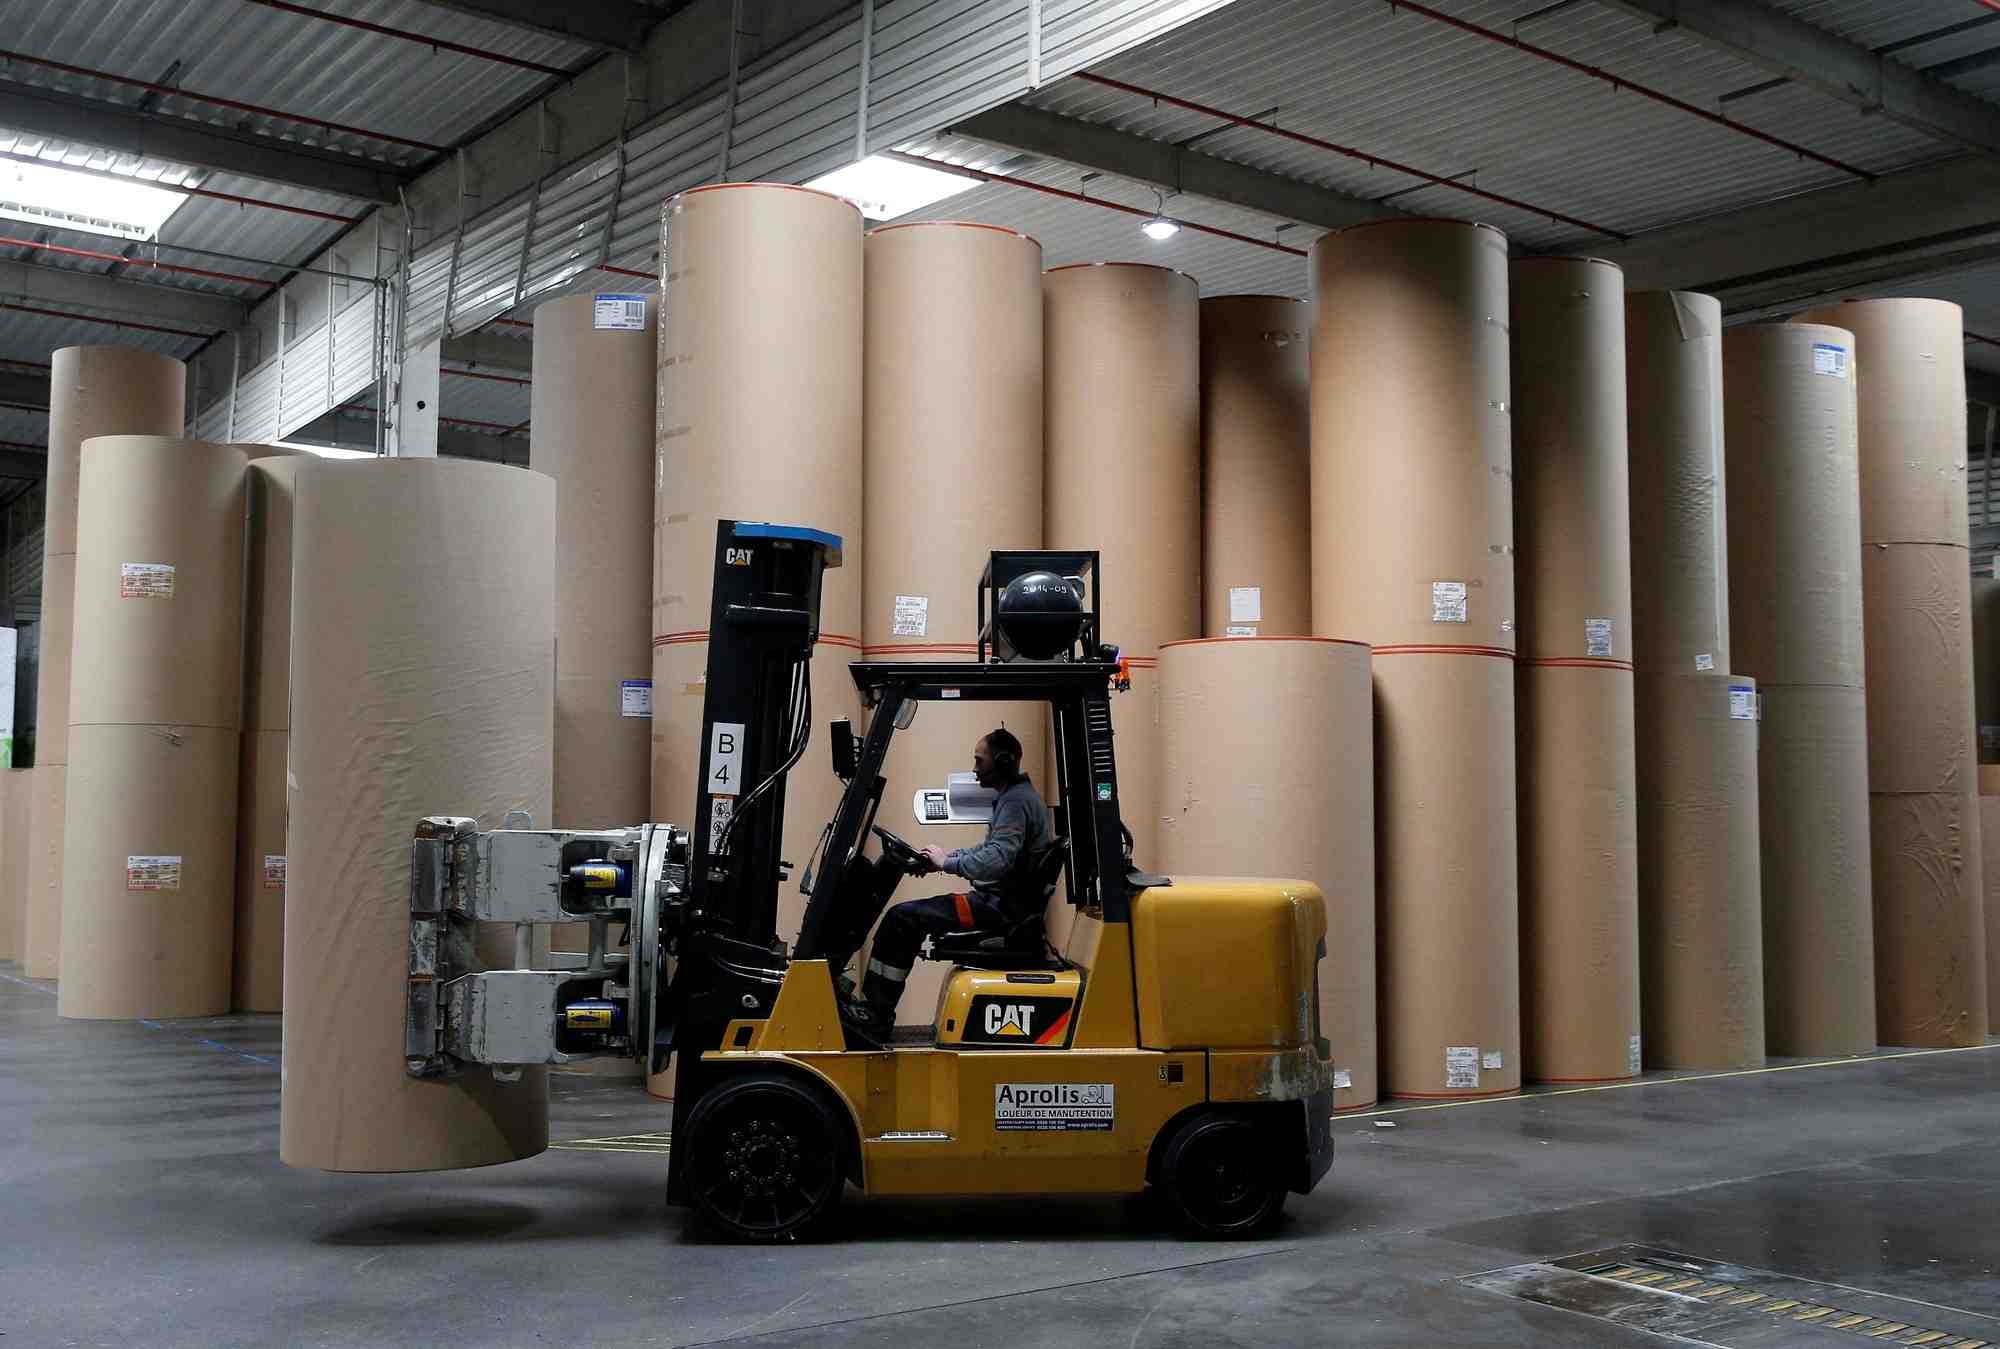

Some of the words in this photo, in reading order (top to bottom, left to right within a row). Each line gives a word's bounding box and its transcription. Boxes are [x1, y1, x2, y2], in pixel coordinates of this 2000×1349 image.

[726, 548, 754, 566] CAT
[718, 733, 735, 754] B
[714, 764, 729, 784] 4
[984, 1003, 1035, 1036] CAT
[998, 1085, 1080, 1108] Aprolis
[998, 1109, 1033, 1118] LOUEUR
[1034, 1109, 1047, 1118] DE
[1048, 1109, 1113, 1118] MANUTENTION
